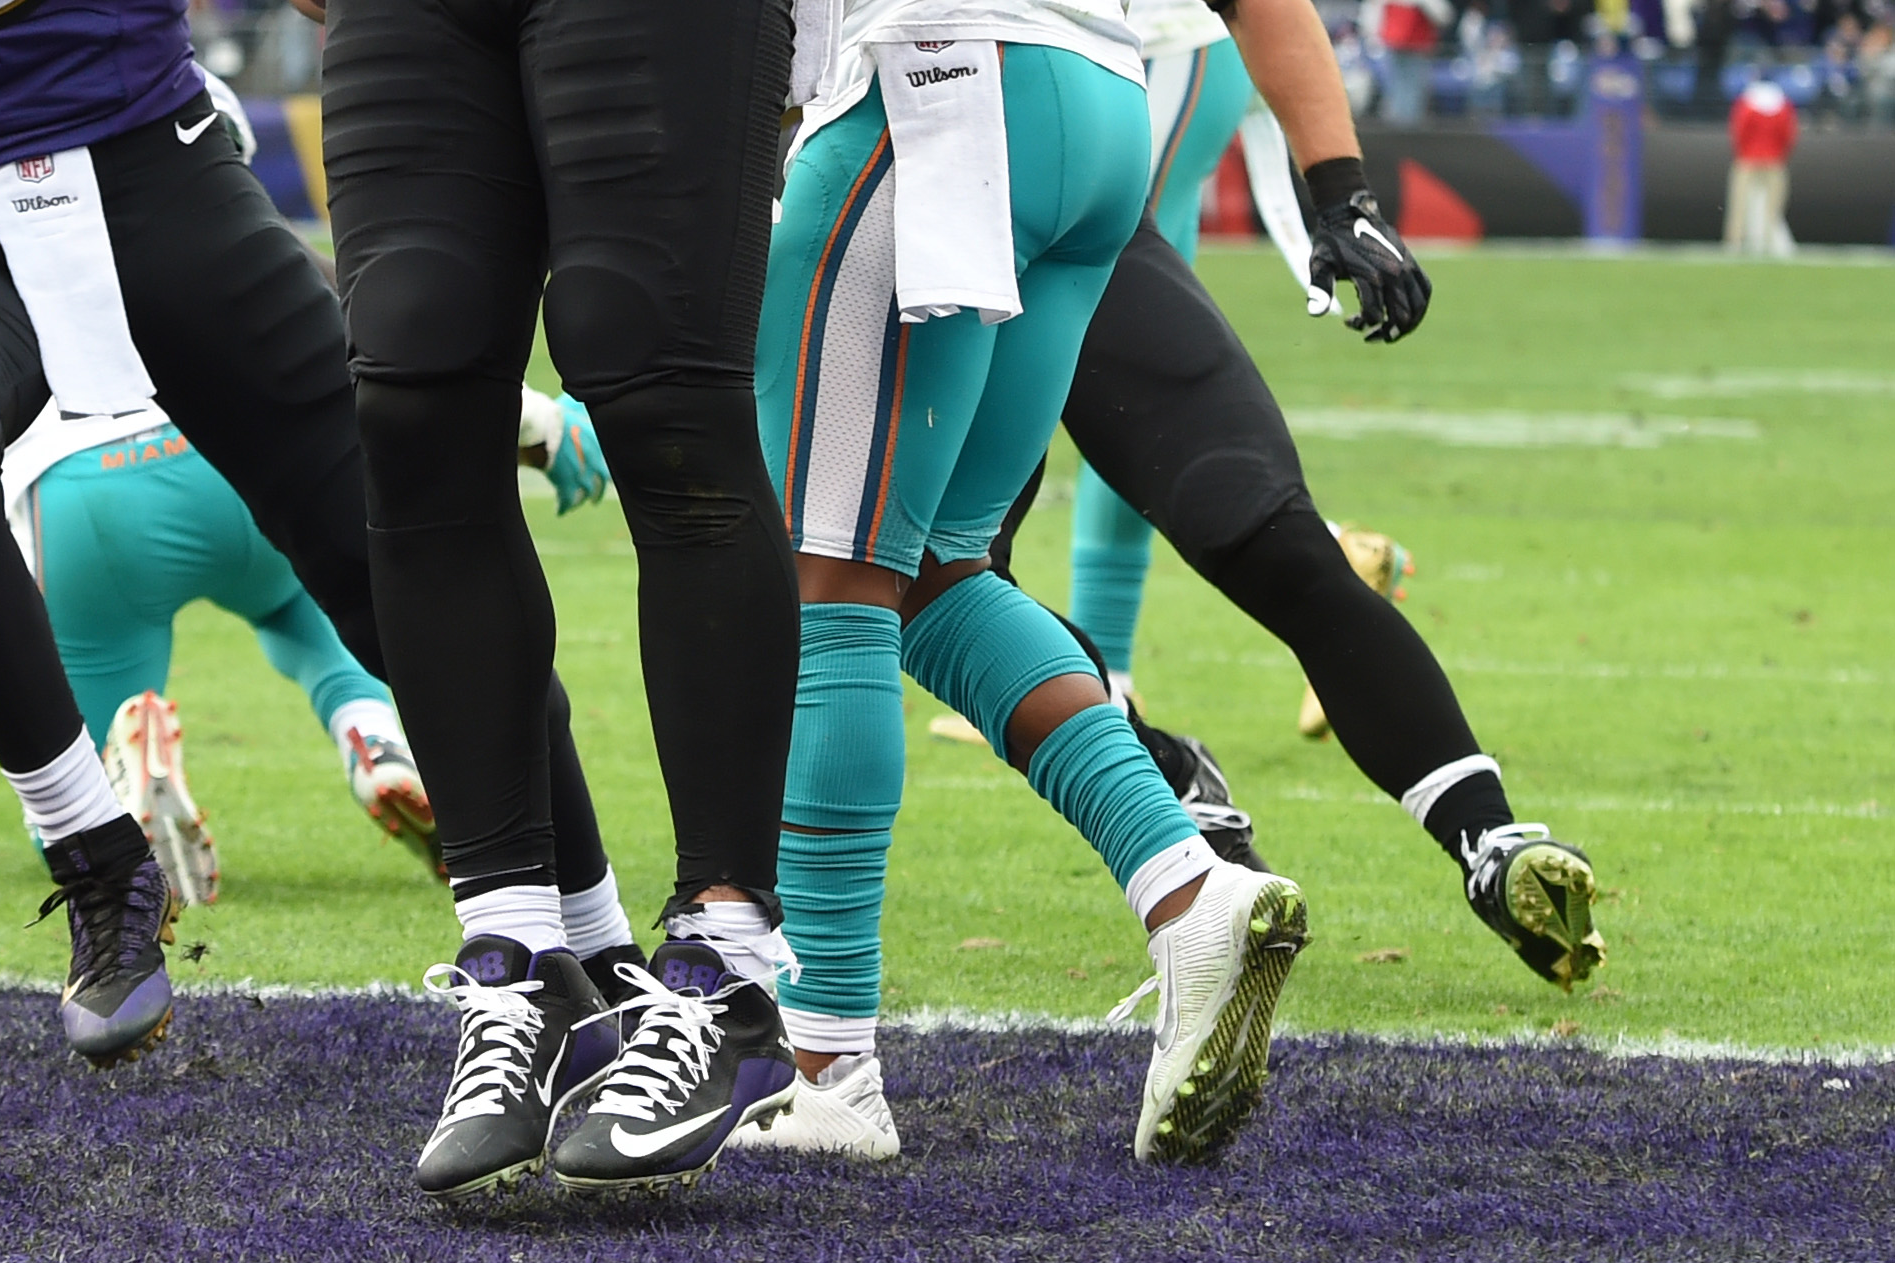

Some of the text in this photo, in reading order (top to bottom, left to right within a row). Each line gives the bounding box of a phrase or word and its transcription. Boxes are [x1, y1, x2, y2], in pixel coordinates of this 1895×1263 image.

[905, 66, 972, 87] Wilson
[19, 155, 52, 178] NFL
[11, 195, 72, 213] Wilson
[102, 435, 187, 471] MIAM
